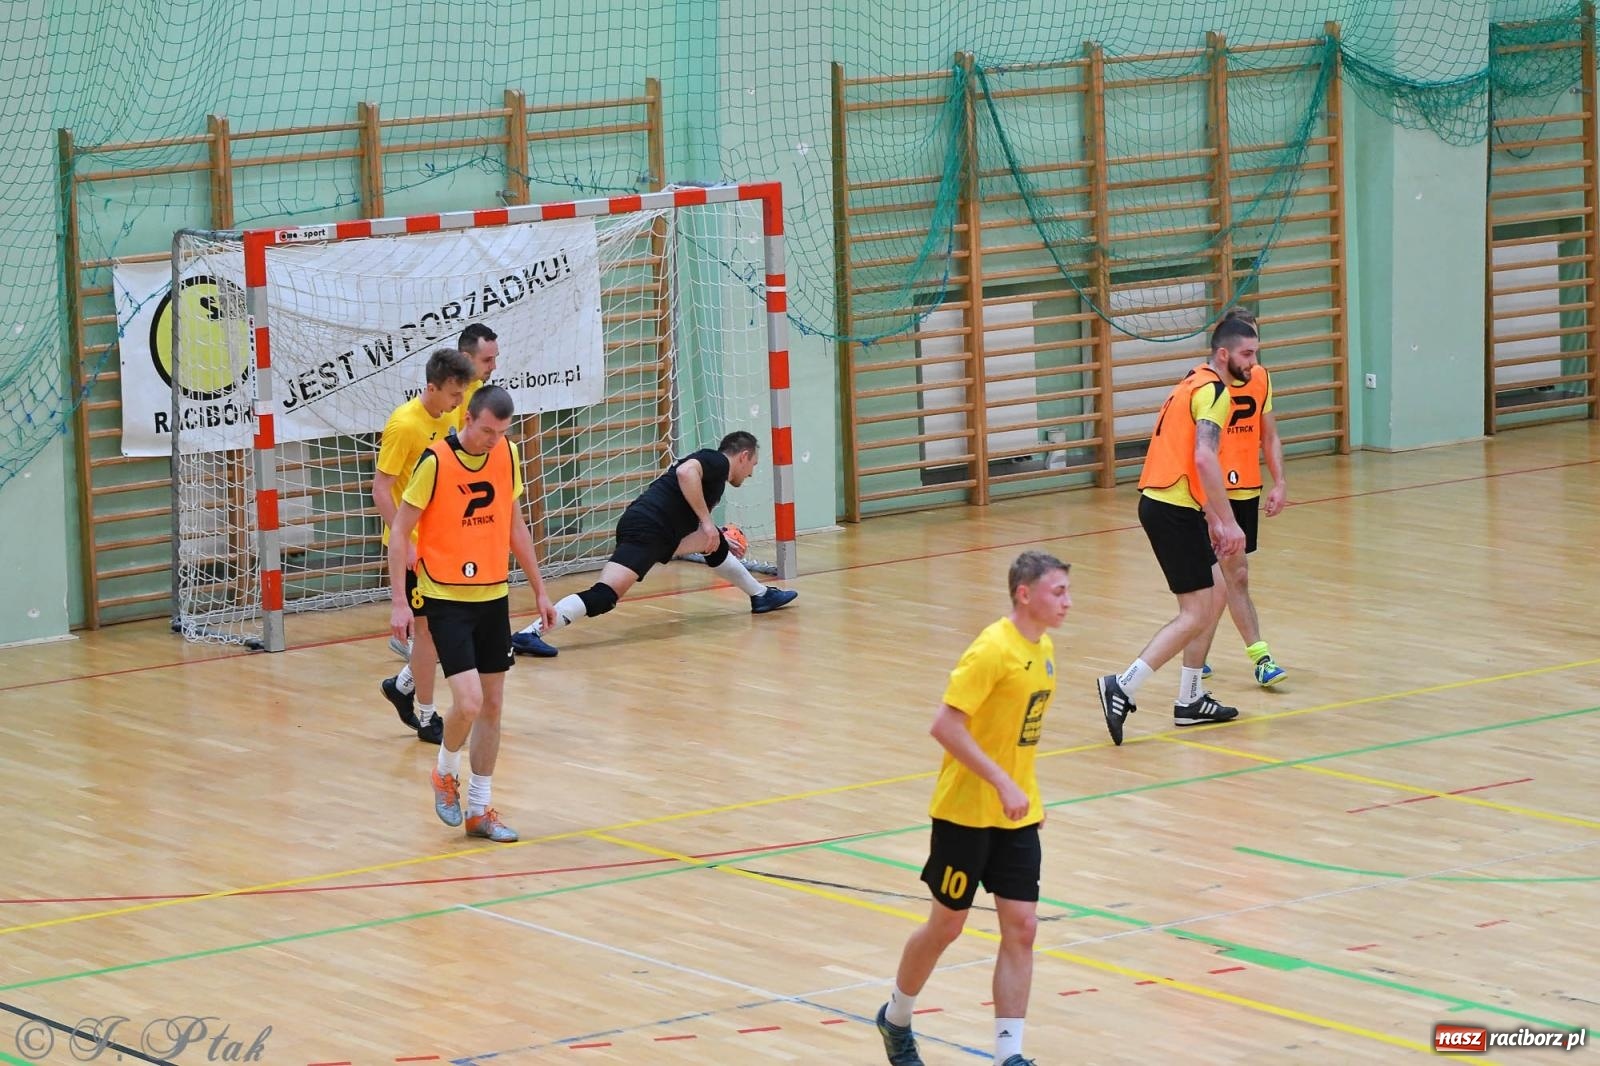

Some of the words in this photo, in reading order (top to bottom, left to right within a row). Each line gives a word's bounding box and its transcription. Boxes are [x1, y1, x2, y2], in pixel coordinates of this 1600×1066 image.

[303, 228, 326, 240] sport
[282, 350, 355, 409] JEST
[362, 334, 394, 368] W
[461, 515, 495, 528] PATRICK
[411, 587, 425, 609] 8
[940, 865, 969, 900] 10
